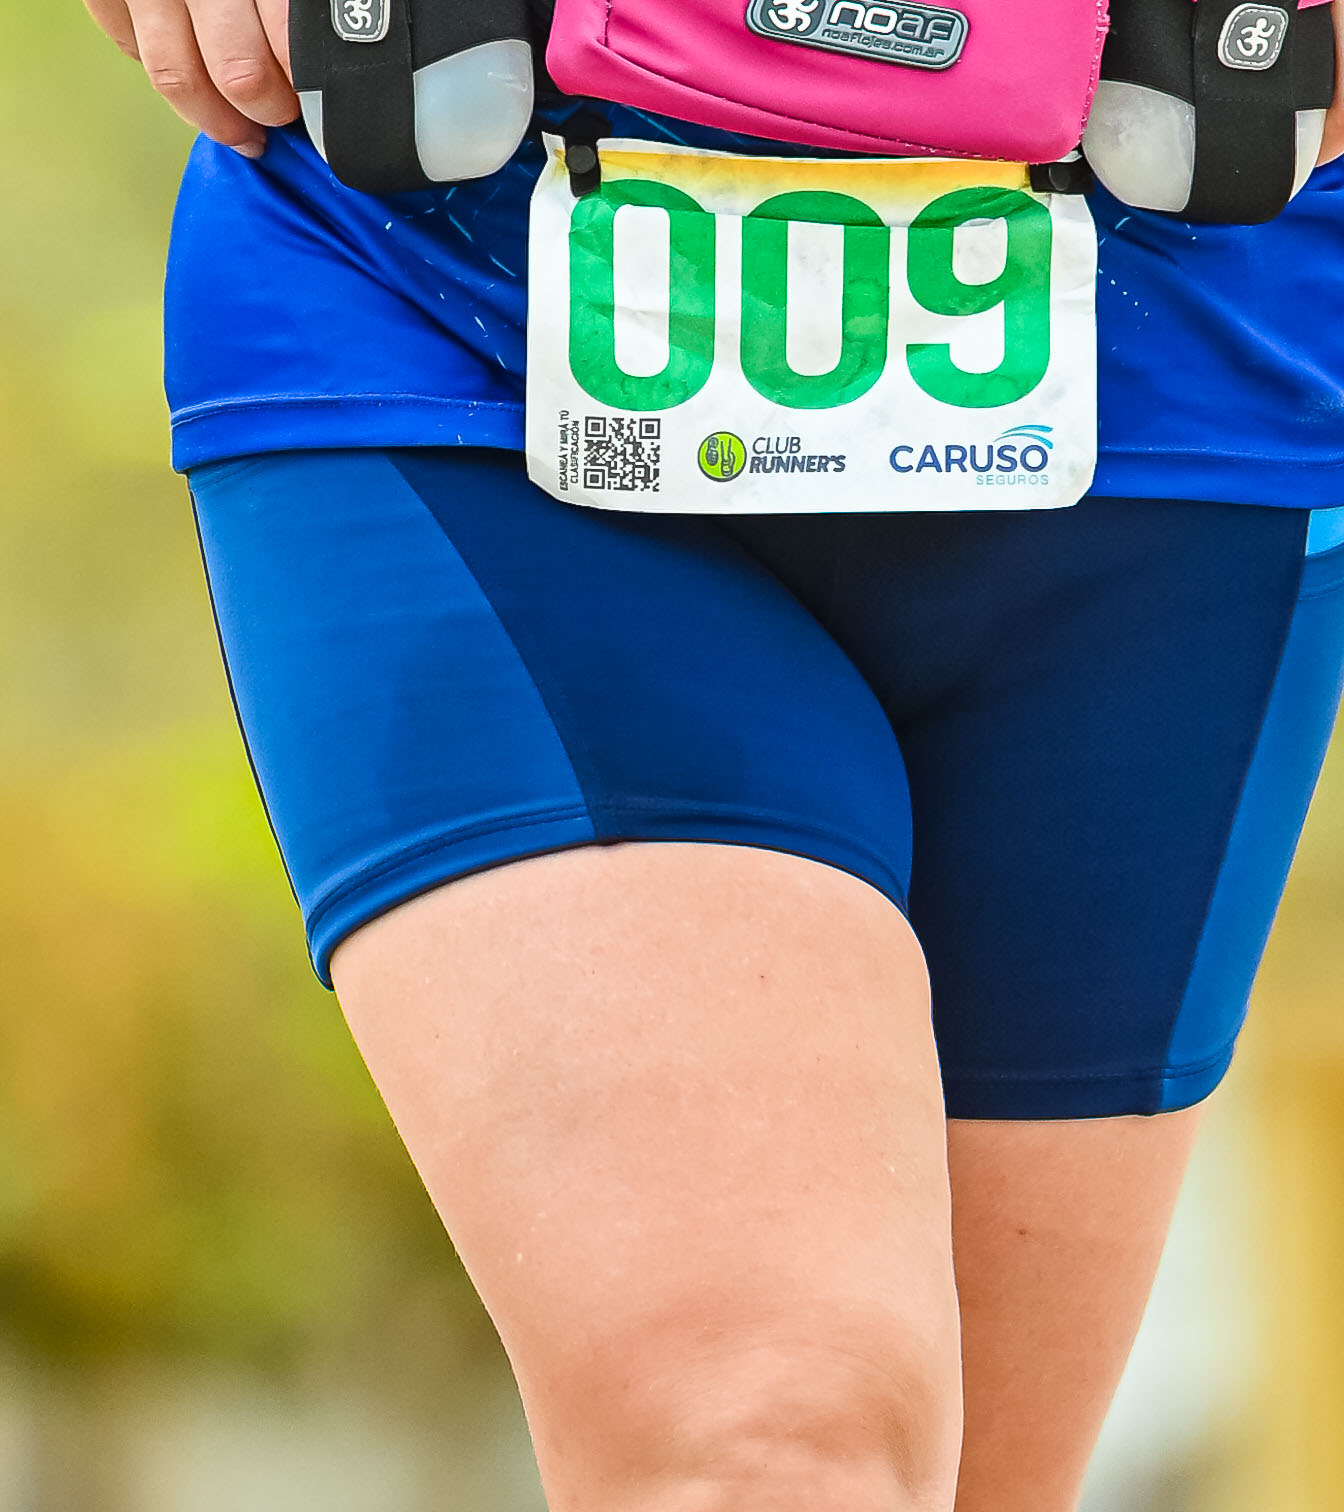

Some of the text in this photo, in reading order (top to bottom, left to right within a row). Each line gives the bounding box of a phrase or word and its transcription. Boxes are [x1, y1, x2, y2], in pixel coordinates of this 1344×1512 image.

[569, 179, 1052, 411] 009
[752, 437, 801, 454] CLUB
[749, 455, 846, 473] RUNNER'S
[889, 444, 1048, 473] CARUSO
[976, 474, 1049, 485] SEGUROS
